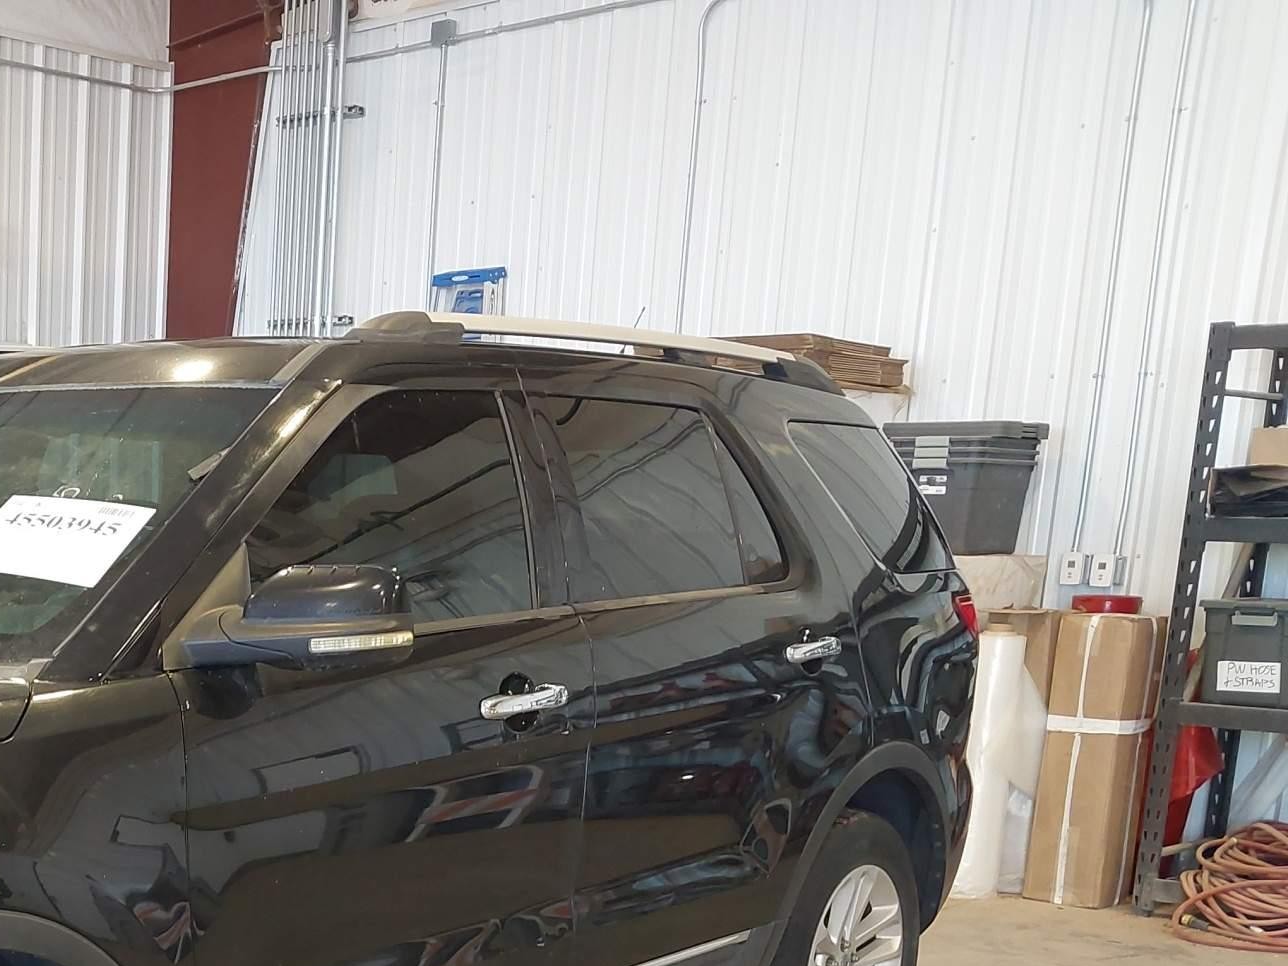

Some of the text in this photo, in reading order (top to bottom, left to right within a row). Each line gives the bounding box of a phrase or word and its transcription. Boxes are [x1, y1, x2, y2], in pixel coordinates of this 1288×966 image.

[4, 511, 123, 536] 45503945
[1227, 662, 1278, 676] PW HOSE
